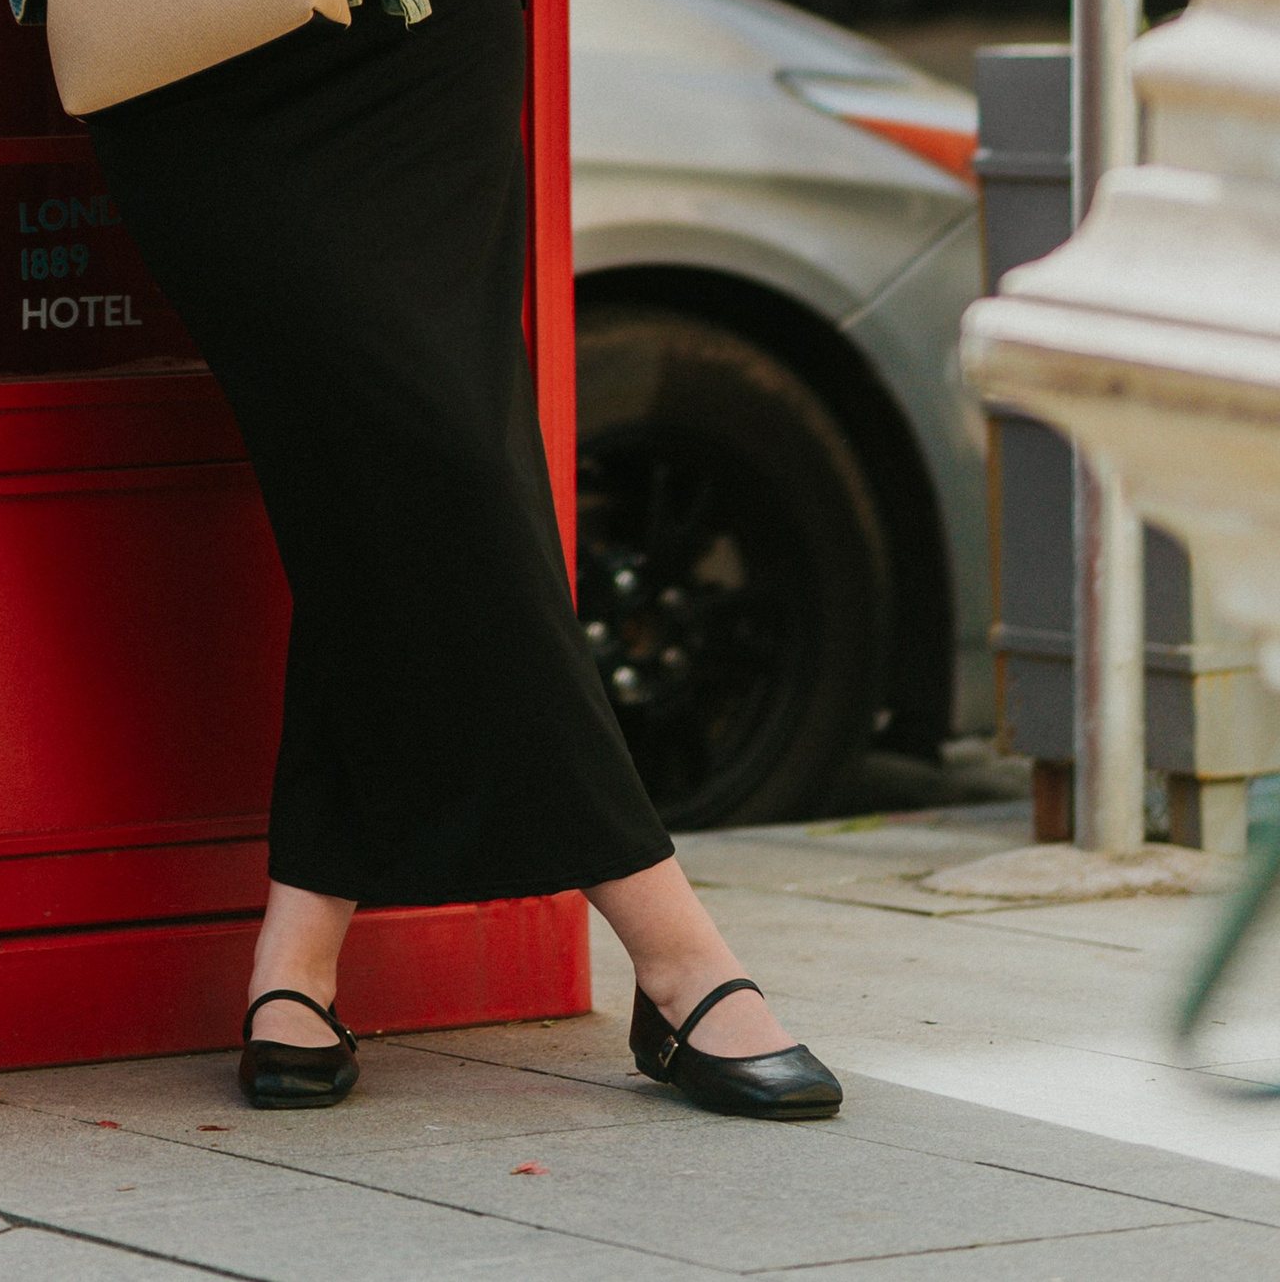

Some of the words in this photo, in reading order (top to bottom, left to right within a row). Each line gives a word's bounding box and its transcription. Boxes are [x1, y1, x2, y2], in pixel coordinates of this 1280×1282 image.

[19, 193, 122, 234] LOND
[20, 244, 89, 281] 1889
[22, 295, 143, 330] HOTEL
